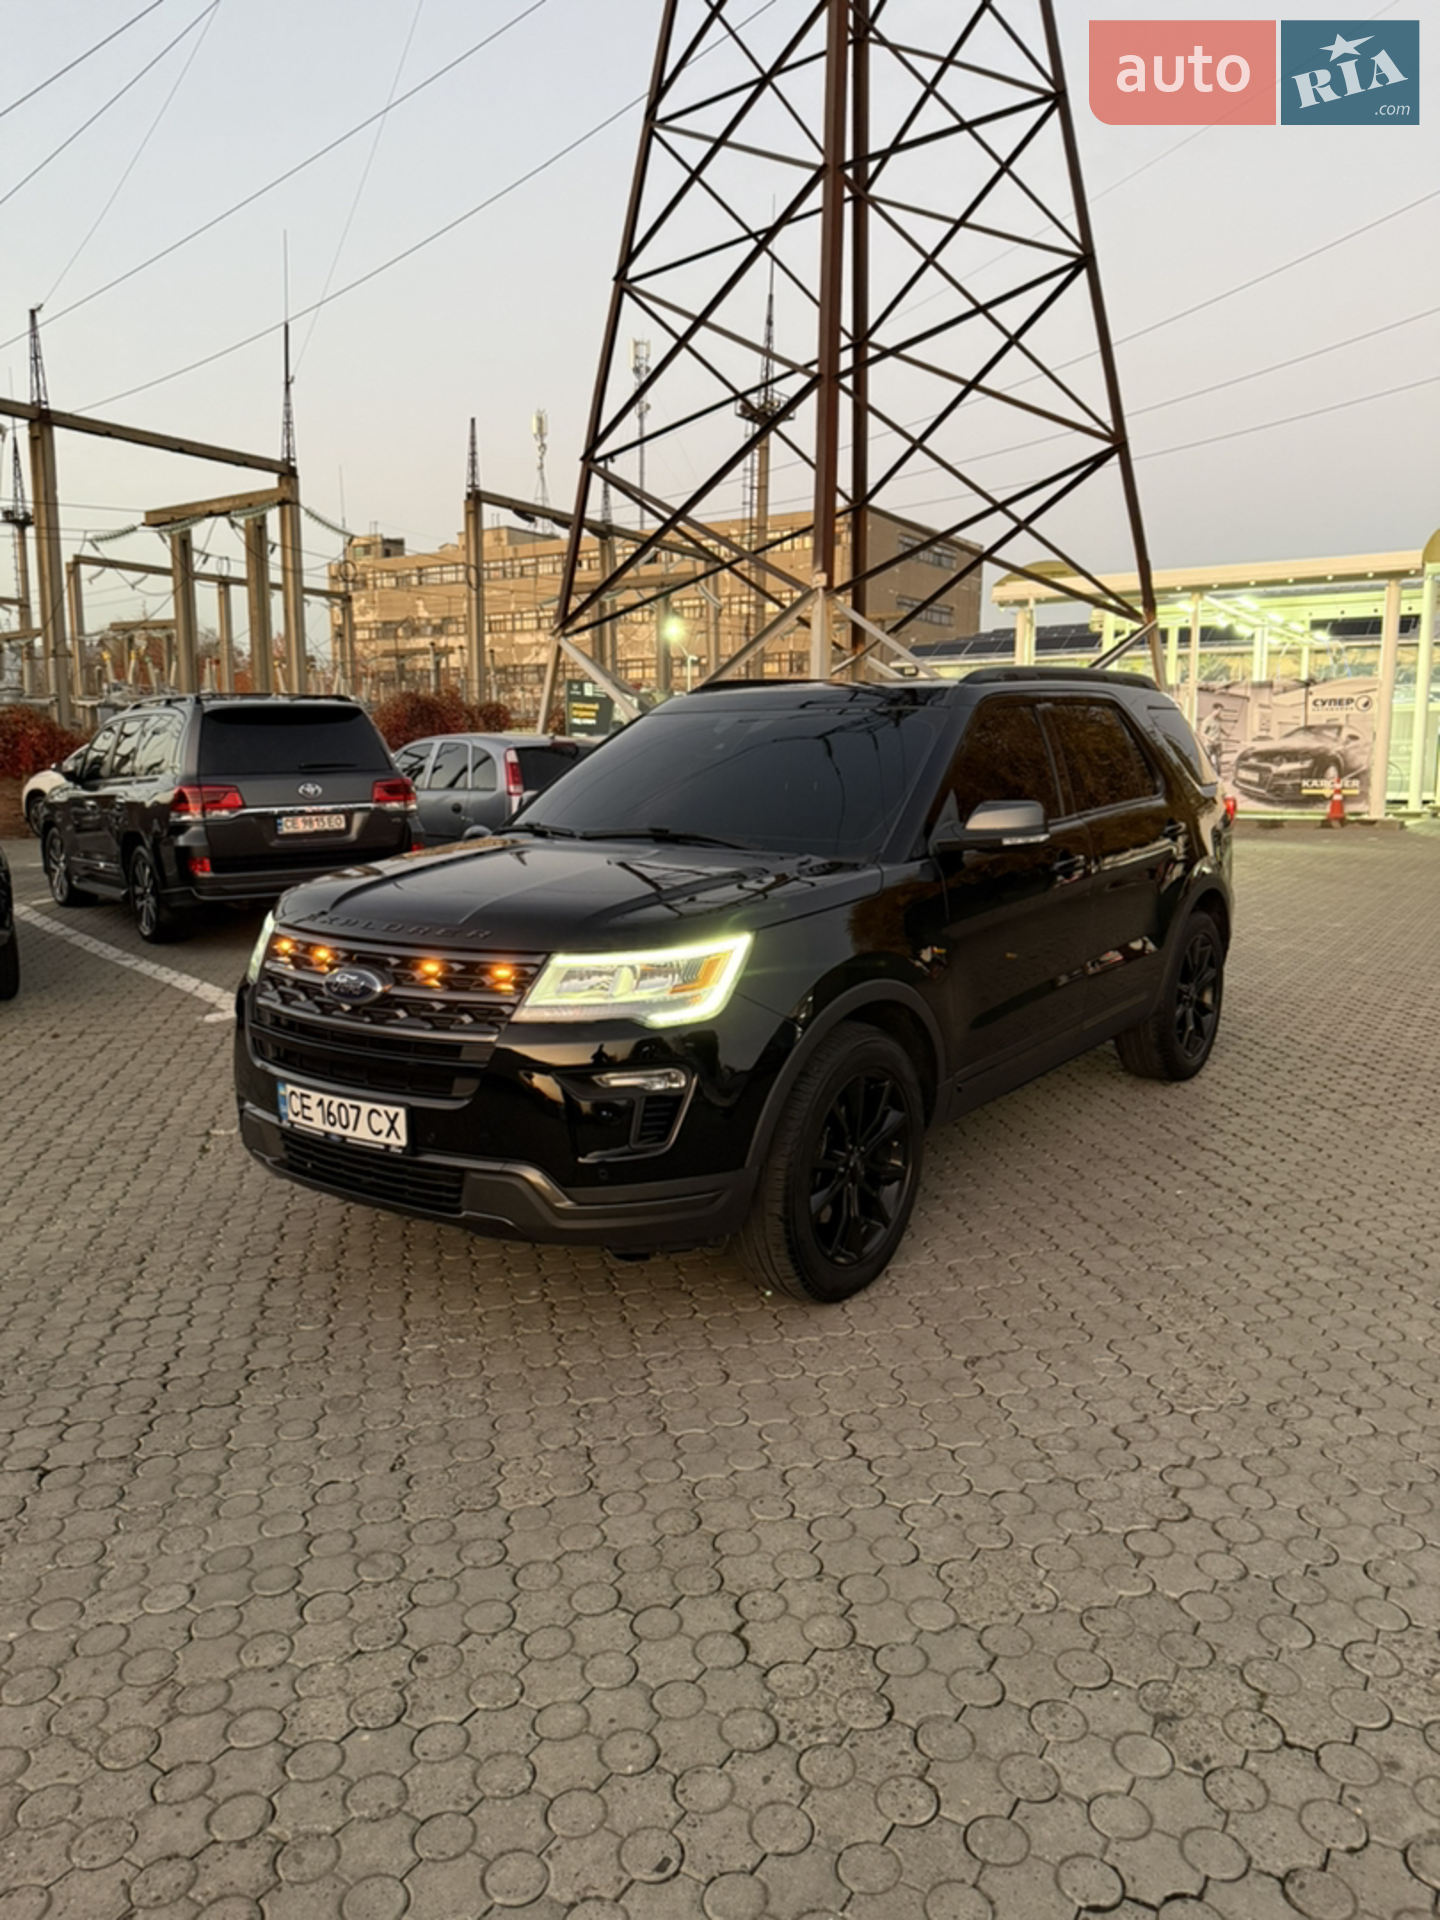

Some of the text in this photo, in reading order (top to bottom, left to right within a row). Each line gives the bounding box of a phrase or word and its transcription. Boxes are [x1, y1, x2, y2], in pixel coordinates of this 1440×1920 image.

[1312, 697, 1355, 707] СУПЕР
[288, 1090, 402, 1141] CE 1607 CX
